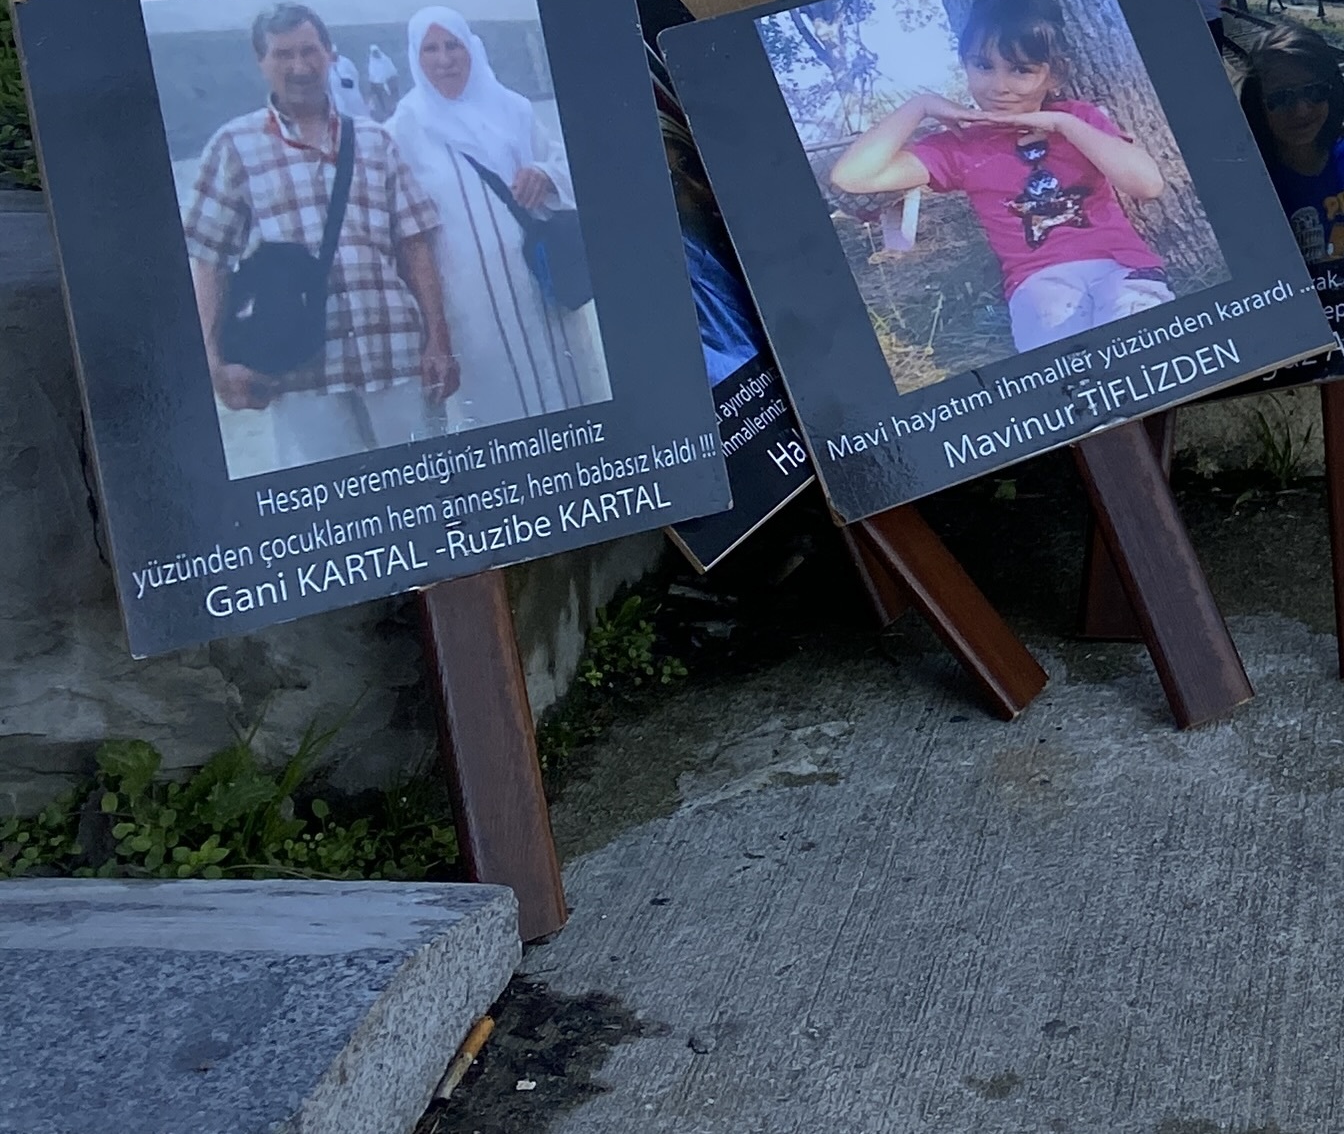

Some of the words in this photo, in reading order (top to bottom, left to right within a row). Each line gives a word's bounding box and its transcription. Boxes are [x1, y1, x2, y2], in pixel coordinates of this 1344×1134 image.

[826, 421, 889, 462] Mavi
[891, 389, 994, 437] hayatım
[995, 352, 1093, 400] ihmaller
[1097, 311, 1214, 370] yüzünden
[1214, 279, 1294, 322] karardı
[943, 402, 1077, 469] Mavinur
[1077, 338, 1241, 417] TİFLİZDEN
[132, 544, 254, 600] yüzünden
[259, 514, 383, 568] çocuklarım
[386, 502, 437, 532] hem
[442, 480, 525, 519] annesiz,
[527, 469, 573, 499] hem
[576, 452, 650, 487] babasız
[652, 436, 698, 470] kaldı
[256, 483, 329, 517] Hesap
[333, 446, 487, 499] veremediğiniz
[488, 420, 605, 465] ihmalleriniz
[767, 432, 807, 475] Ha
[205, 572, 289, 617] Gani
[297, 540, 429, 597] KARTAL
[558, 481, 672, 533] KARTAL
